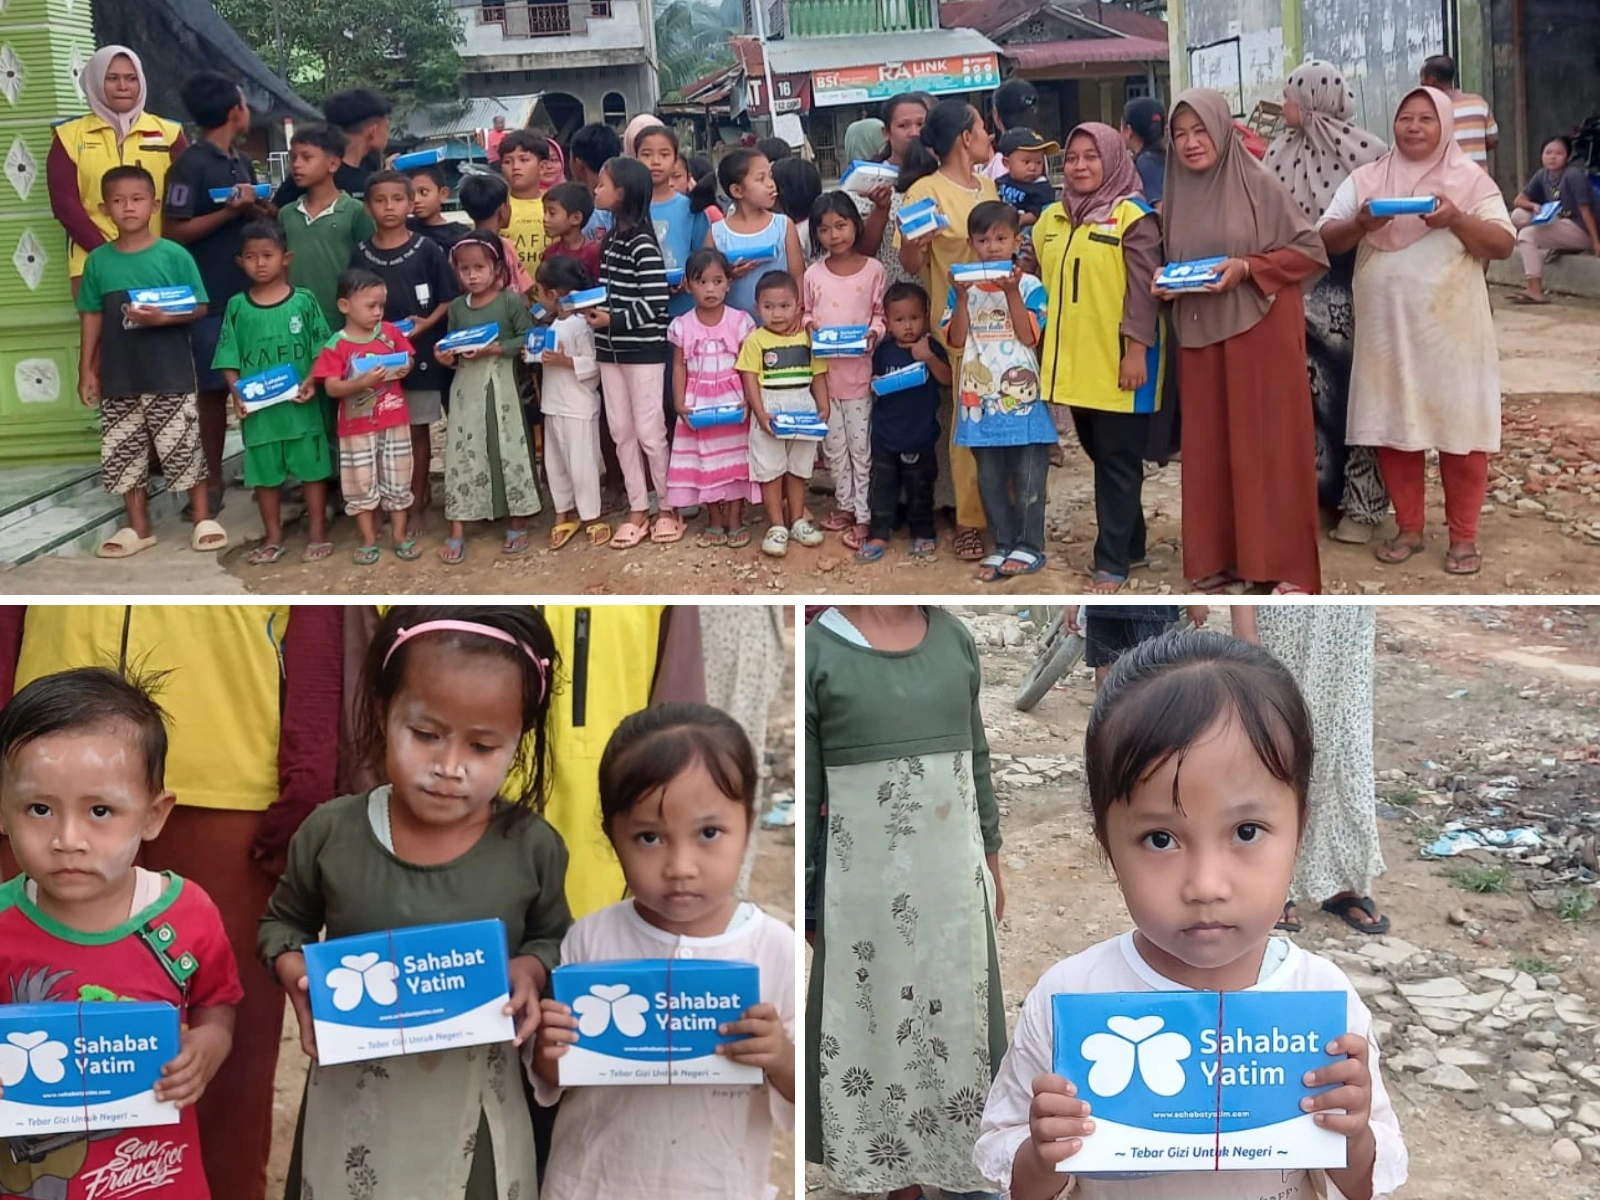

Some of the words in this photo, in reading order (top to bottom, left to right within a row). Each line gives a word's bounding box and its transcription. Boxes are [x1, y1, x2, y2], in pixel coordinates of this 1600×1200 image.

[912, 59, 948, 73] LINK
[241, 343, 305, 368] KAFD
[403, 948, 486, 974] Sahabat
[406, 974, 466, 995] Yatim
[655, 991, 741, 1010] Sahabat
[655, 1014, 717, 1031] Yatim
[74, 1034, 158, 1055] Sahabat
[1200, 1027, 1319, 1055] Sahabat
[75, 1056, 136, 1075] Yatim
[610, 1069, 633, 1077] Tebar
[635, 1069, 651, 1077] Gizi
[681, 1068, 709, 1079] Negeri
[1200, 1060, 1285, 1086] Yatim
[28, 1117, 51, 1126] Tebar
[53, 1116, 70, 1125] Gizi
[100, 1112, 128, 1123] Negeri
[109, 1137, 173, 1171] San
[1131, 1147, 1164, 1158] Tebar
[1167, 1146, 1189, 1158] Gizi
[1232, 1145, 1273, 1160] Negeri
